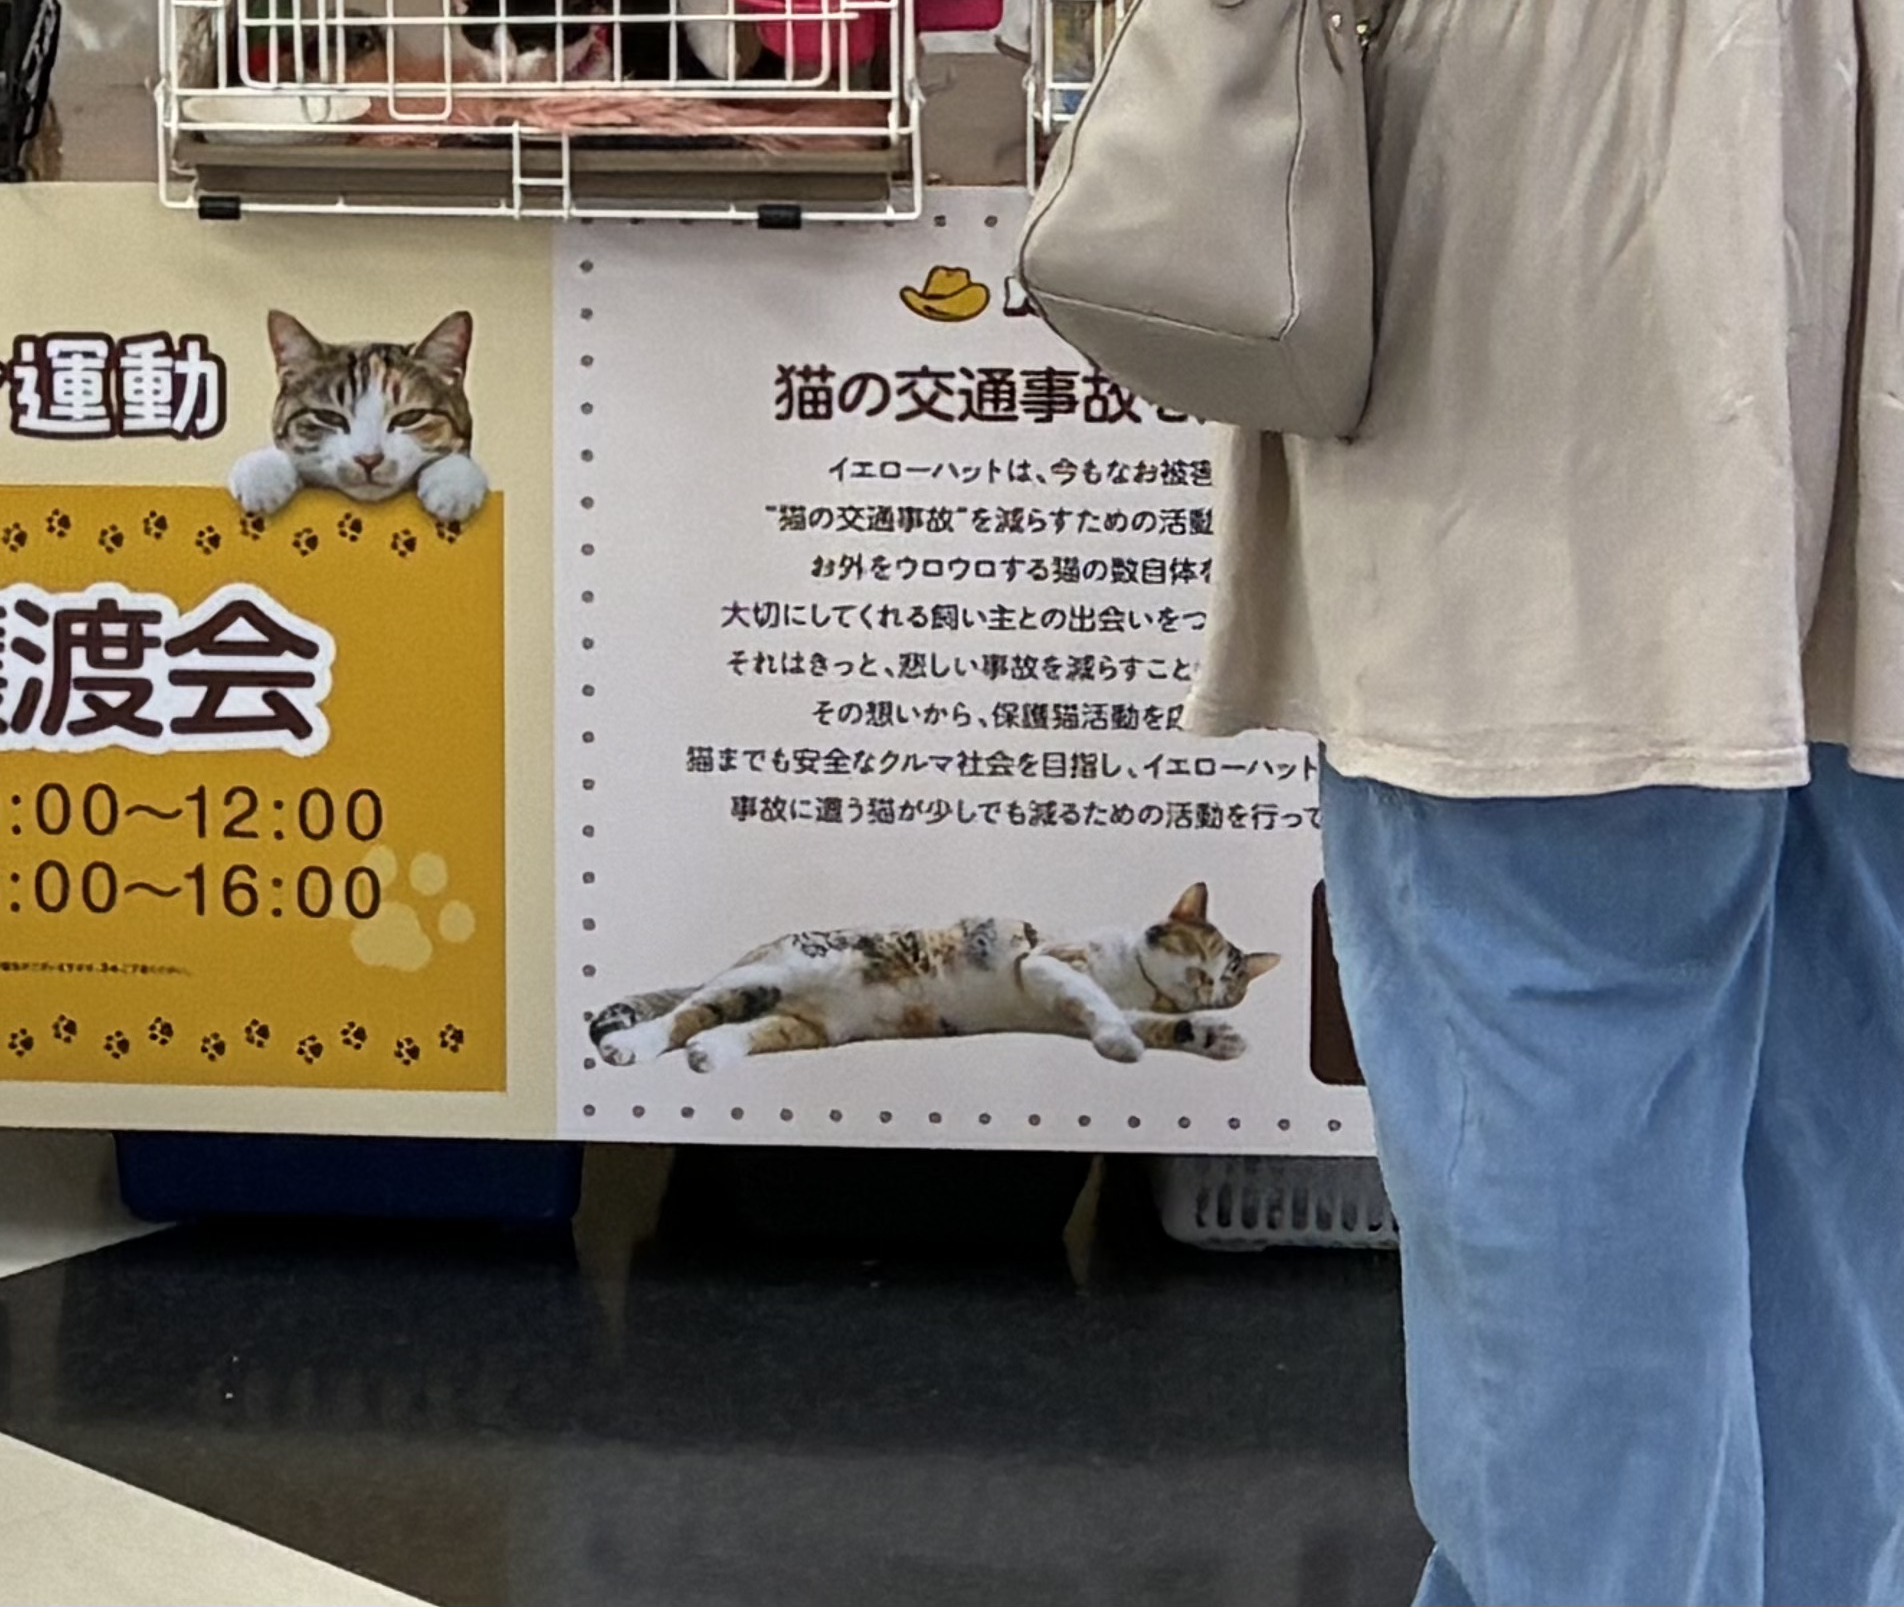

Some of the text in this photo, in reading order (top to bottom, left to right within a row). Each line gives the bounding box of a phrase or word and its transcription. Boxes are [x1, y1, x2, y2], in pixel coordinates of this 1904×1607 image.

[726, 649, 1198, 682] それはきっと、悲しい事故を減らすこと
